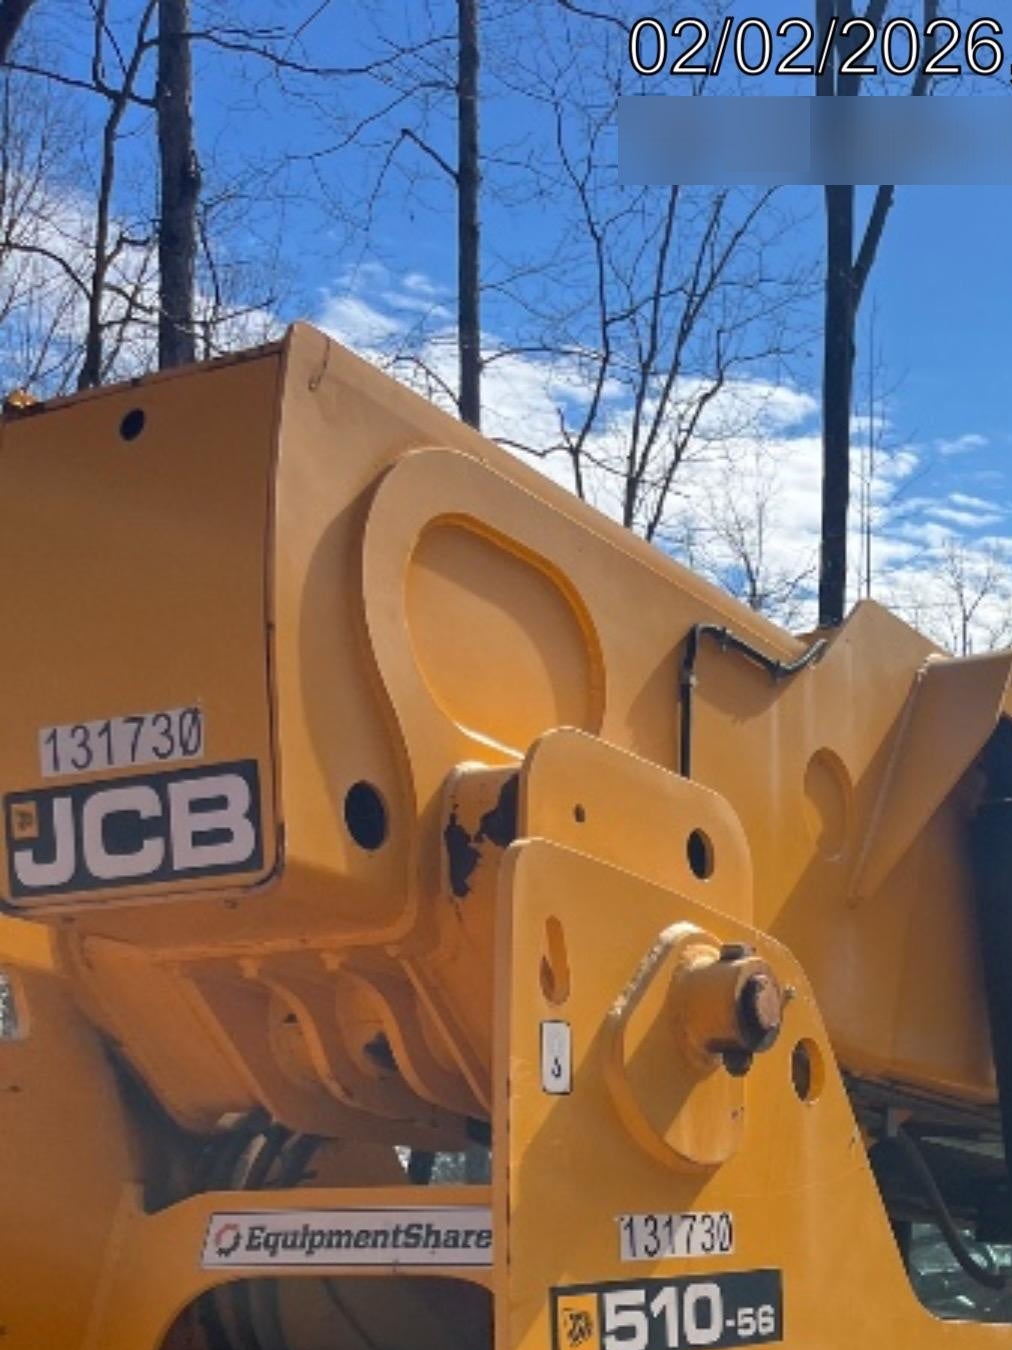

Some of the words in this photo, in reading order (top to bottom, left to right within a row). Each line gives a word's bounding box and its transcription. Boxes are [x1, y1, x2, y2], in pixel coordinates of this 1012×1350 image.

[45, 707, 202, 772] 131730
[14, 773, 256, 887] JCB
[245, 1223, 492, 1257] EquipmentShare
[624, 1212, 733, 1257] 131730
